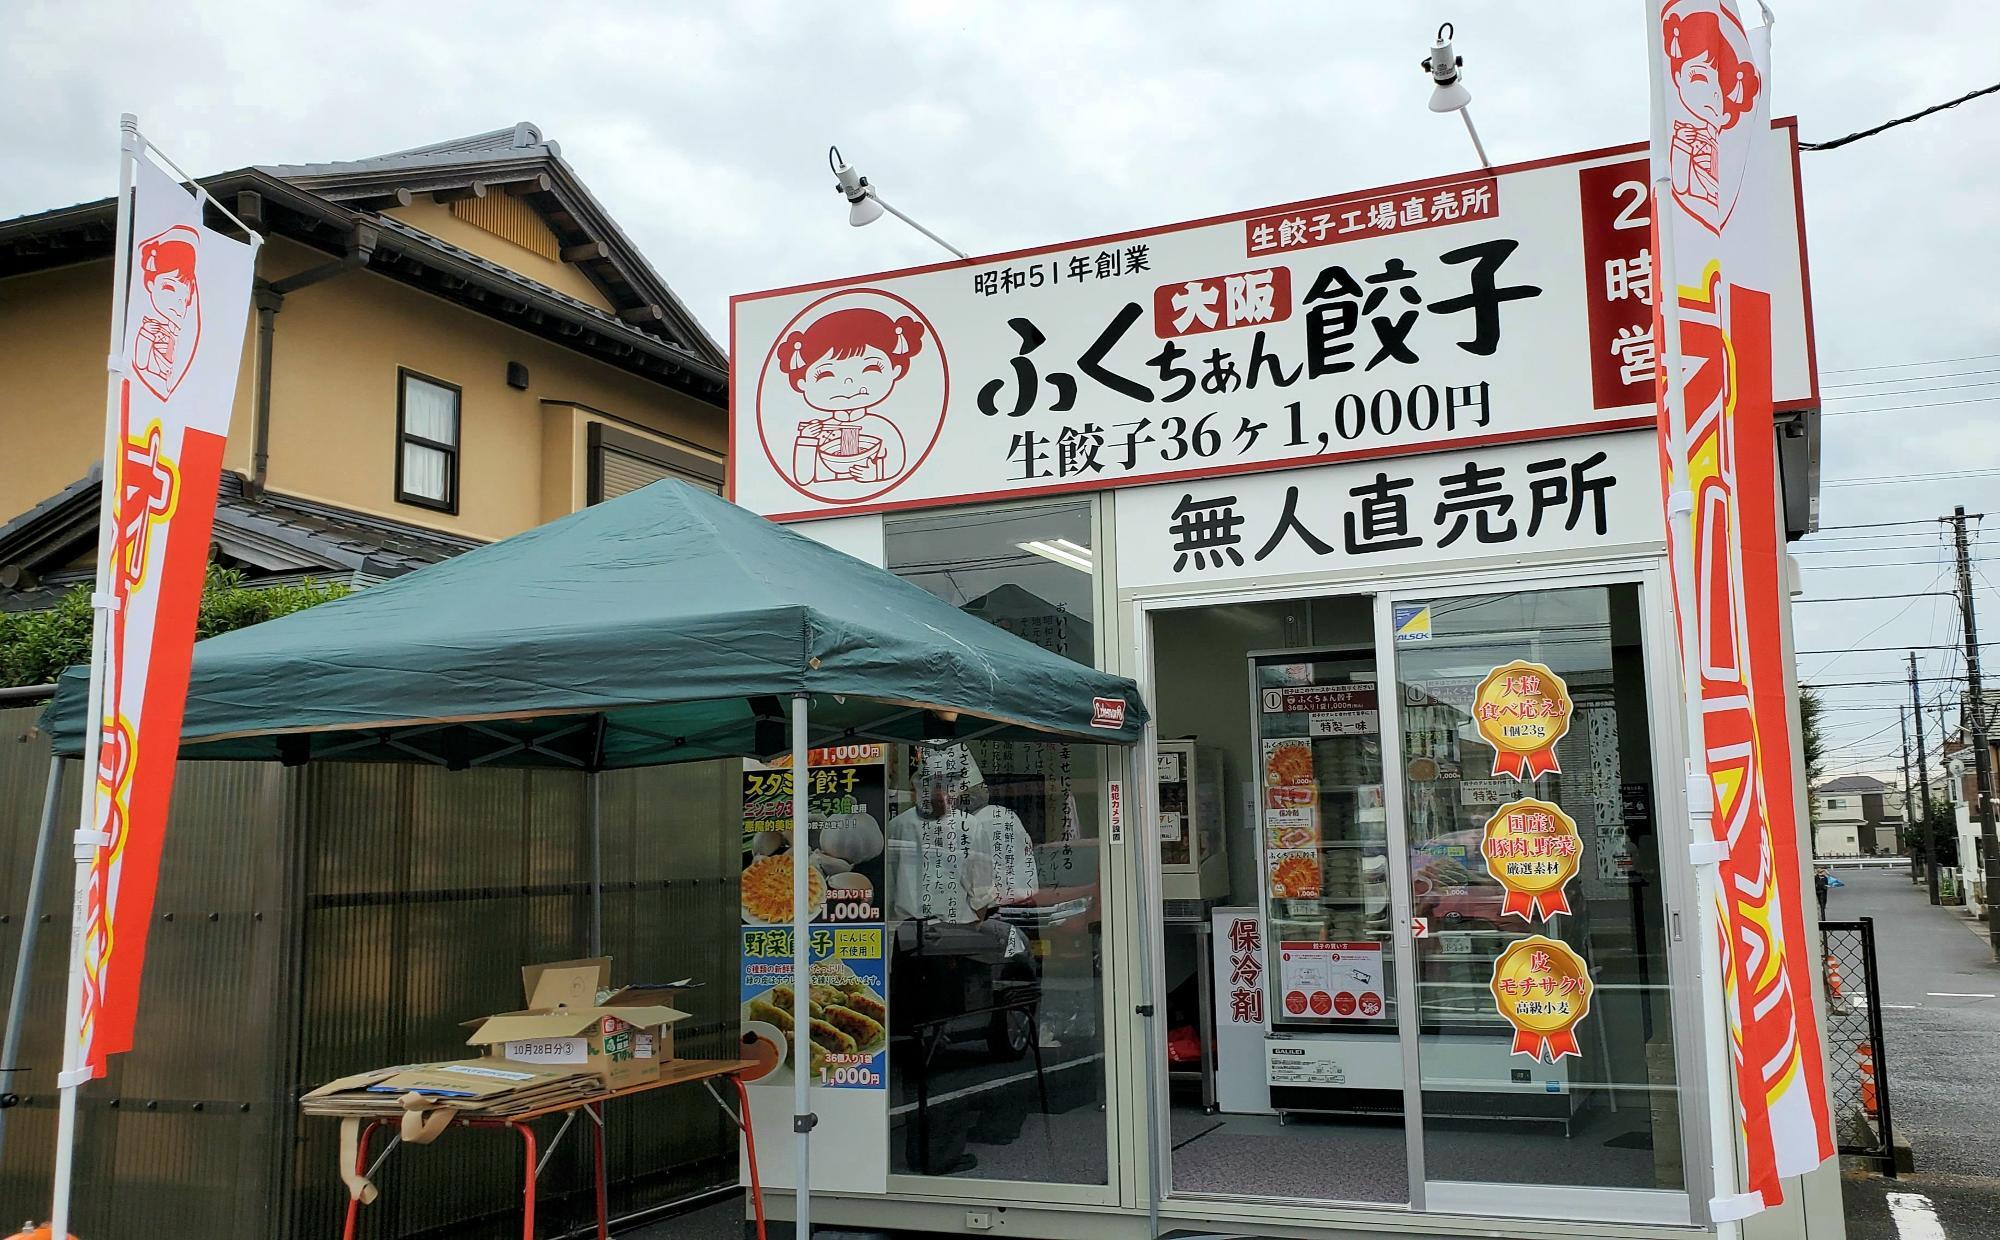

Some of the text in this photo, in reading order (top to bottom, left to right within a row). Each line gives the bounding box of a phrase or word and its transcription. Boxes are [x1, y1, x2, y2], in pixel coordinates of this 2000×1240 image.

[1250, 184, 1493, 253] 生餃子工場直売所
[974, 244, 1151, 297] 昭和51年創業
[1170, 269, 1276, 334] 大阪
[1168, 451, 1617, 573] 無人直売所
[1396, 633, 1429, 641] ALSOK
[1502, 675, 1542, 697] 大粒
[1479, 698, 1567, 722] 食べ応え!
[1320, 721, 1367, 732] 特製一味
[1502, 724, 1547, 737] 1個23g
[821, 743, 880, 763] 1,000円
[745, 768, 861, 796] スタミ餃子
[1059, 742, 1073, 872] 幸せにする力がある
[1111, 784, 1120, 841] 防犯カメラ設置
[1506, 814, 1556, 836] 国産!
[1488, 837, 1577, 859] 豚肉、野菜
[1506, 861, 1559, 876] 厳選素材
[820, 902, 880, 924] 1,000円
[839, 933, 876, 943] にんにく
[839, 947, 876, 957] 不使用!
[1530, 951, 1552, 974] 皮
[745, 976, 881, 987] 緑の皮はホウレを練り込んでいます。
[1228, 918, 1265, 1024] 保冷剤
[1500, 976, 1586, 997] モチサク!
[1516, 1001, 1571, 1016] 高級小麦
[819, 1067, 880, 1086] 1,000円
